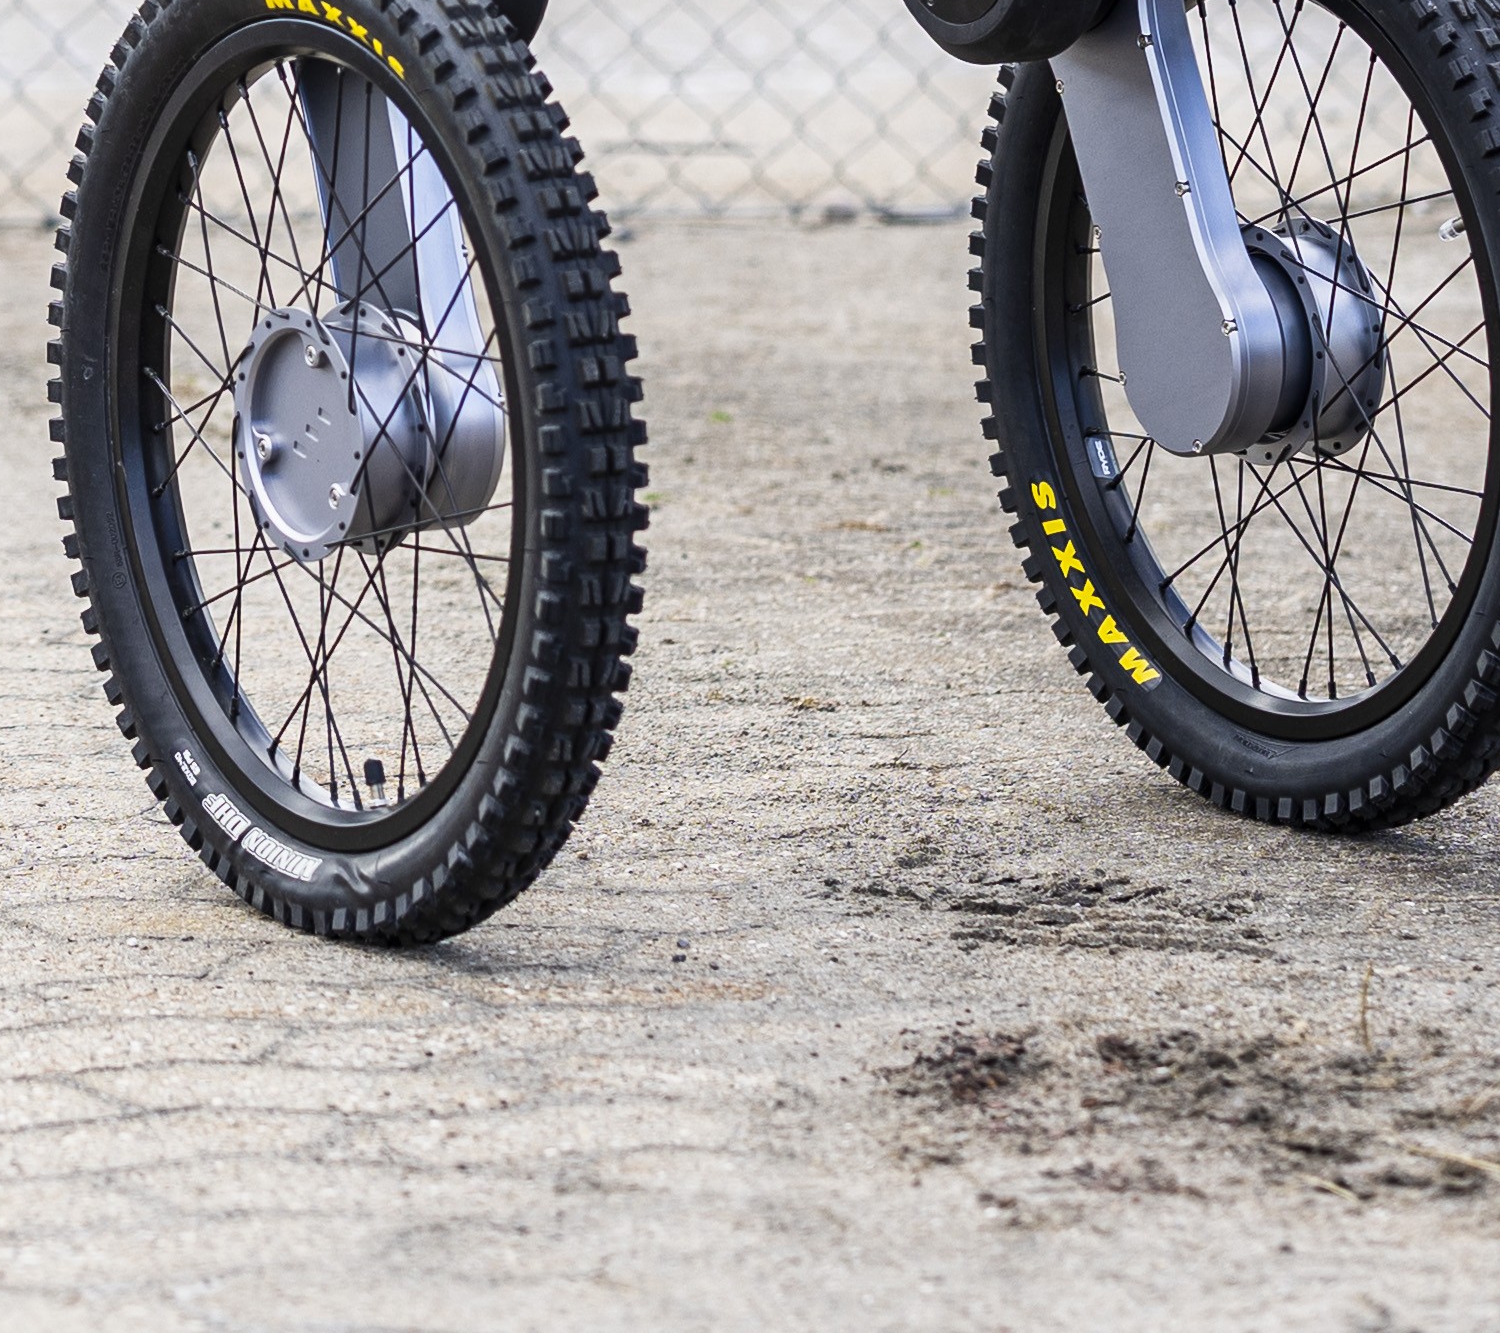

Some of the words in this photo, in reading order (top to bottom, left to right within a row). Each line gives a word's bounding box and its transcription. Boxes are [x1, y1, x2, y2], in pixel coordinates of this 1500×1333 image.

[1095, 440, 1111, 475] RYDE
[1031, 481, 1160, 685] MAXXIS
[202, 793, 251, 841] DHF
[241, 827, 323, 882] MINION
